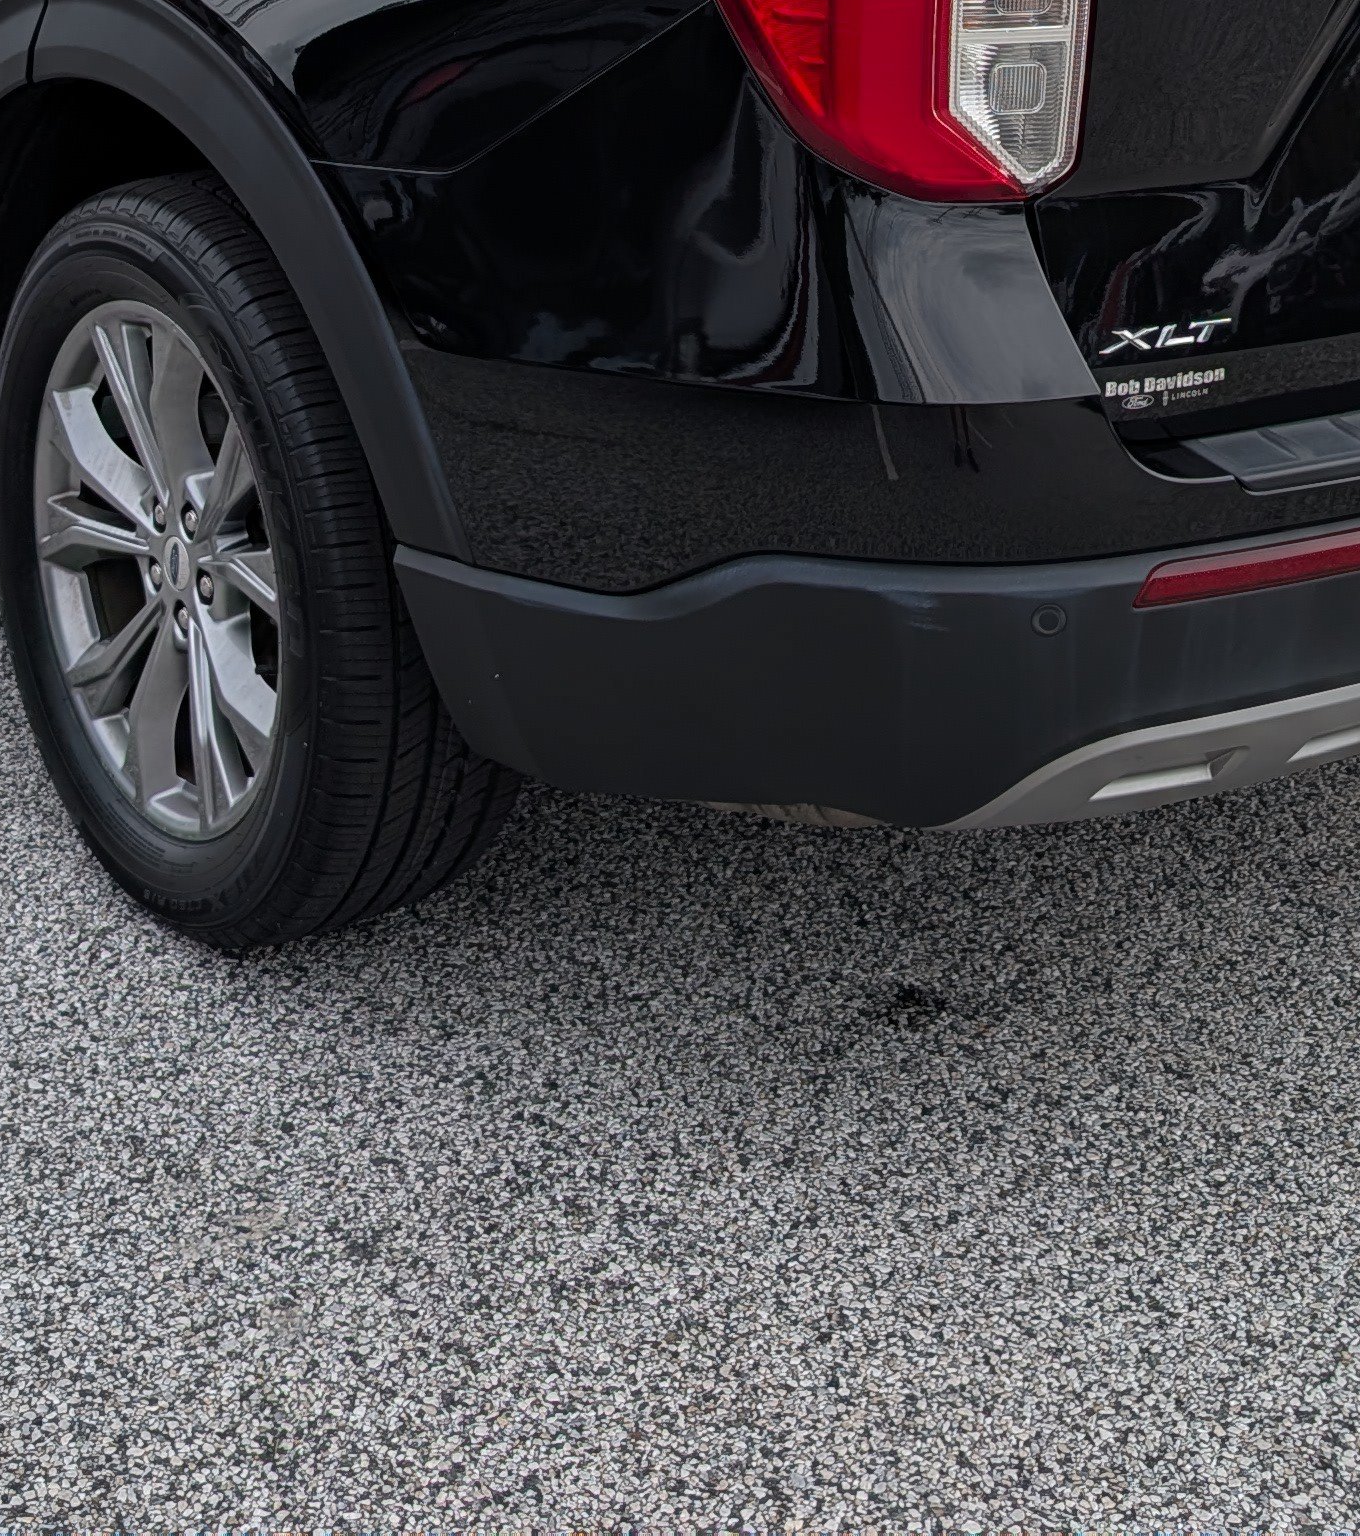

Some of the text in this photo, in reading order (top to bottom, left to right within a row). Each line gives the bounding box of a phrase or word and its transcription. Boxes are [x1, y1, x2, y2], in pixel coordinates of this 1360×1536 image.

[1098, 317, 1233, 355] XLT
[1105, 367, 1226, 397] Bob Davidson
[1171, 387, 1209, 401] LINCOLN
